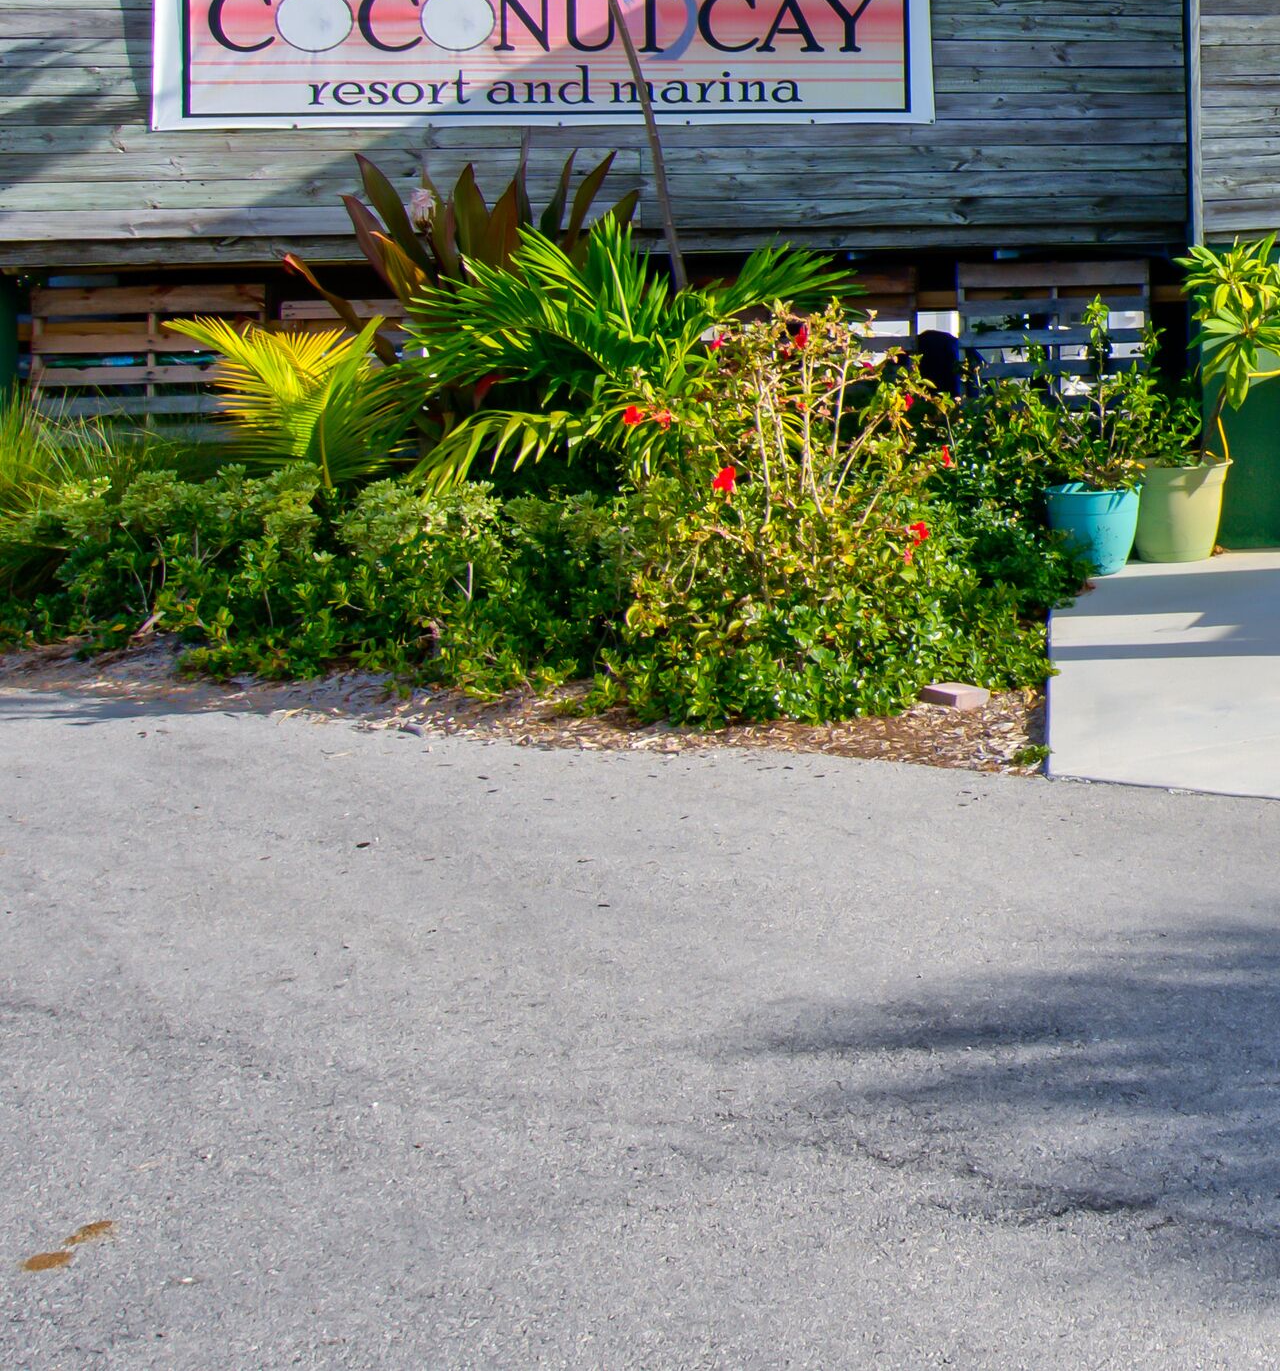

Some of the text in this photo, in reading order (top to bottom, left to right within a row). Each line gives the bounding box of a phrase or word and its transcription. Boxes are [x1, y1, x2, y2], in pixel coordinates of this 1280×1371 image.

[308, 65, 802, 106] resort and marina
